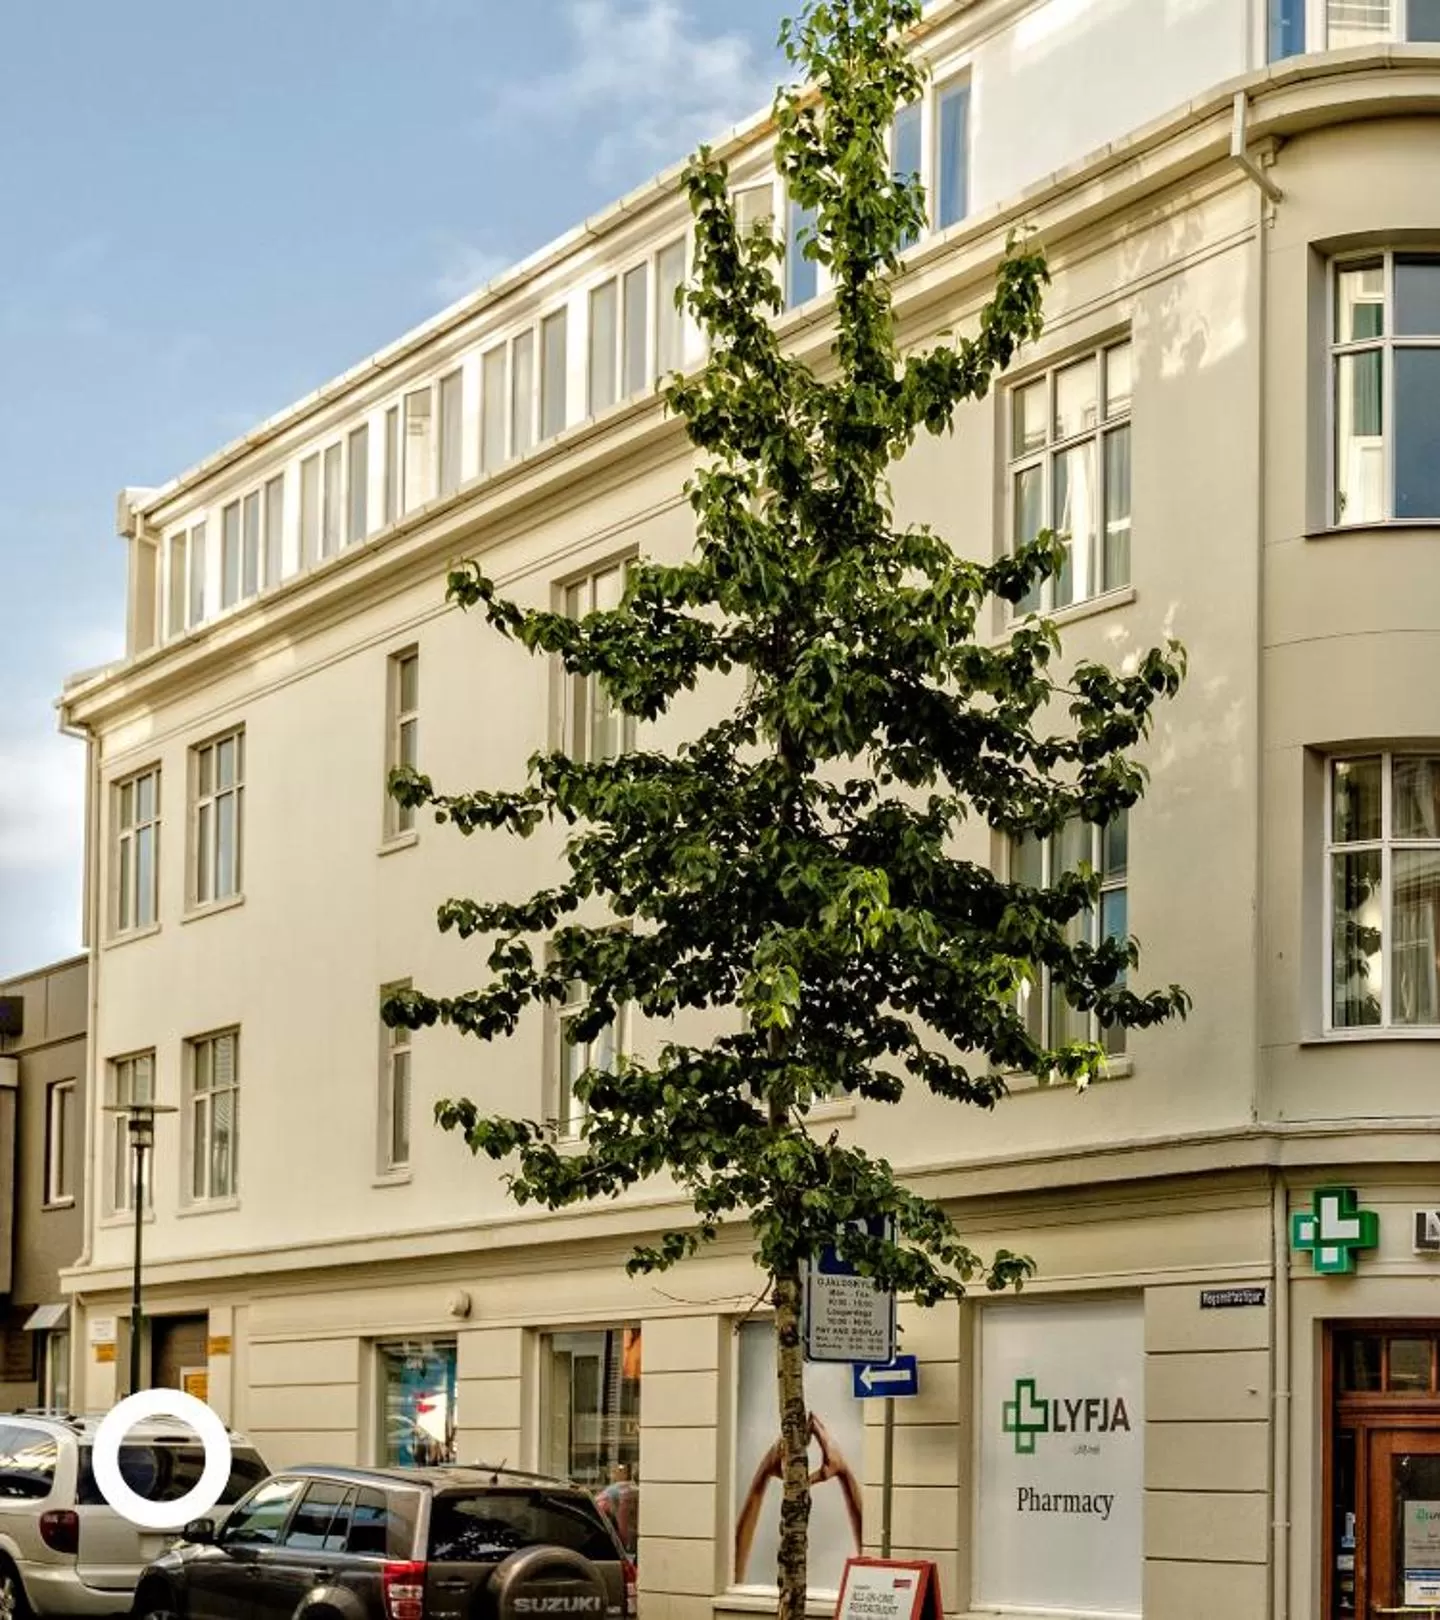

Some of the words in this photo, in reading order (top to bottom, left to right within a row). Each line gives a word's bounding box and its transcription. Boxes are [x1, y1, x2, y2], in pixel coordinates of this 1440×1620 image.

[1053, 1398, 1131, 1433] LYFJA
[1017, 1487, 1115, 1521] Pharmacy
[514, 1597, 600, 1613] SUZUKI
